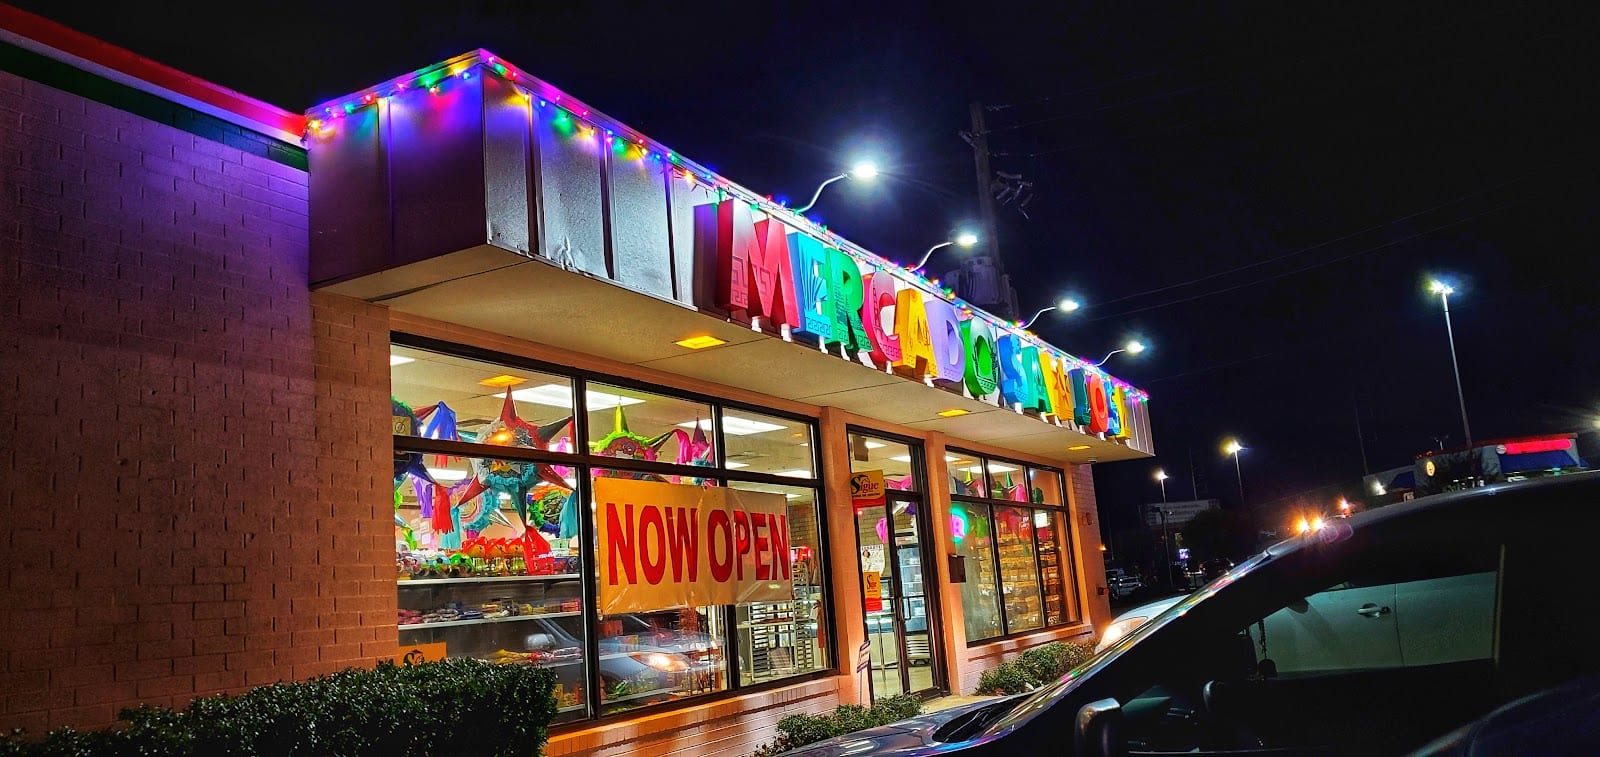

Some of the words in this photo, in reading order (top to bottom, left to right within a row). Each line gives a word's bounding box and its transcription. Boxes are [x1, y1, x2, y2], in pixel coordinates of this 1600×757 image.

[716, 198, 999, 397] MERCADO
[998, 334, 1074, 421] SAN
[1068, 368, 1132, 440] JOSE
[851, 474, 879, 494] Sigue
[606, 502, 699, 586] NOW
[707, 509, 790, 582] OPEN
